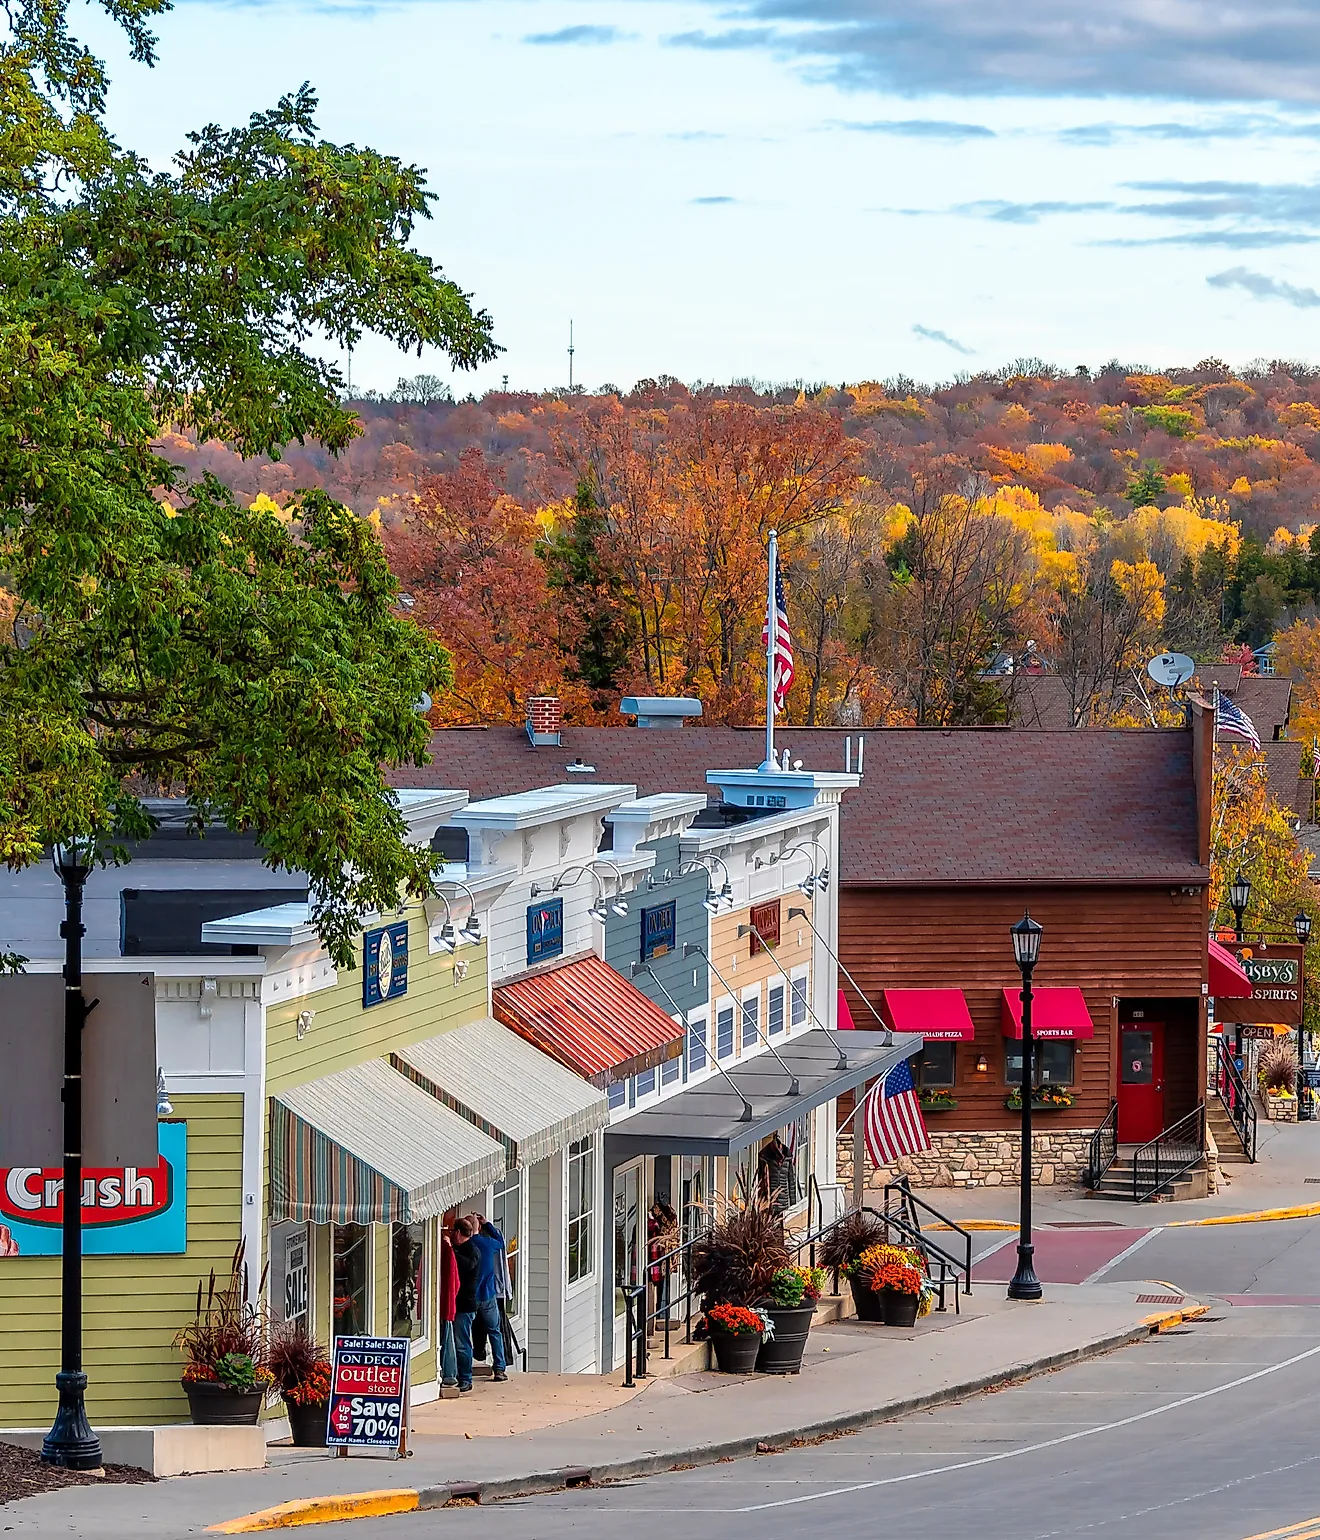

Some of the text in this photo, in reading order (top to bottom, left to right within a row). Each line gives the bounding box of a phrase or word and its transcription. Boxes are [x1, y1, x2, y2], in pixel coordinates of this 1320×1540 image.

[1254, 989, 1298, 1000] SPIRITS
[1243, 1027, 1272, 1037] OPEN
[285, 1266, 307, 1319] SALE
[344, 1340, 406, 1350] Sale! Sale! Sale!
[341, 1354, 399, 1365] ON DECK
[340, 1366, 398, 1384] outlet
[368, 1384, 396, 1393] store
[339, 1405, 350, 1414] Up
[350, 1397, 400, 1417] Save
[352, 1419, 398, 1437] 70%
